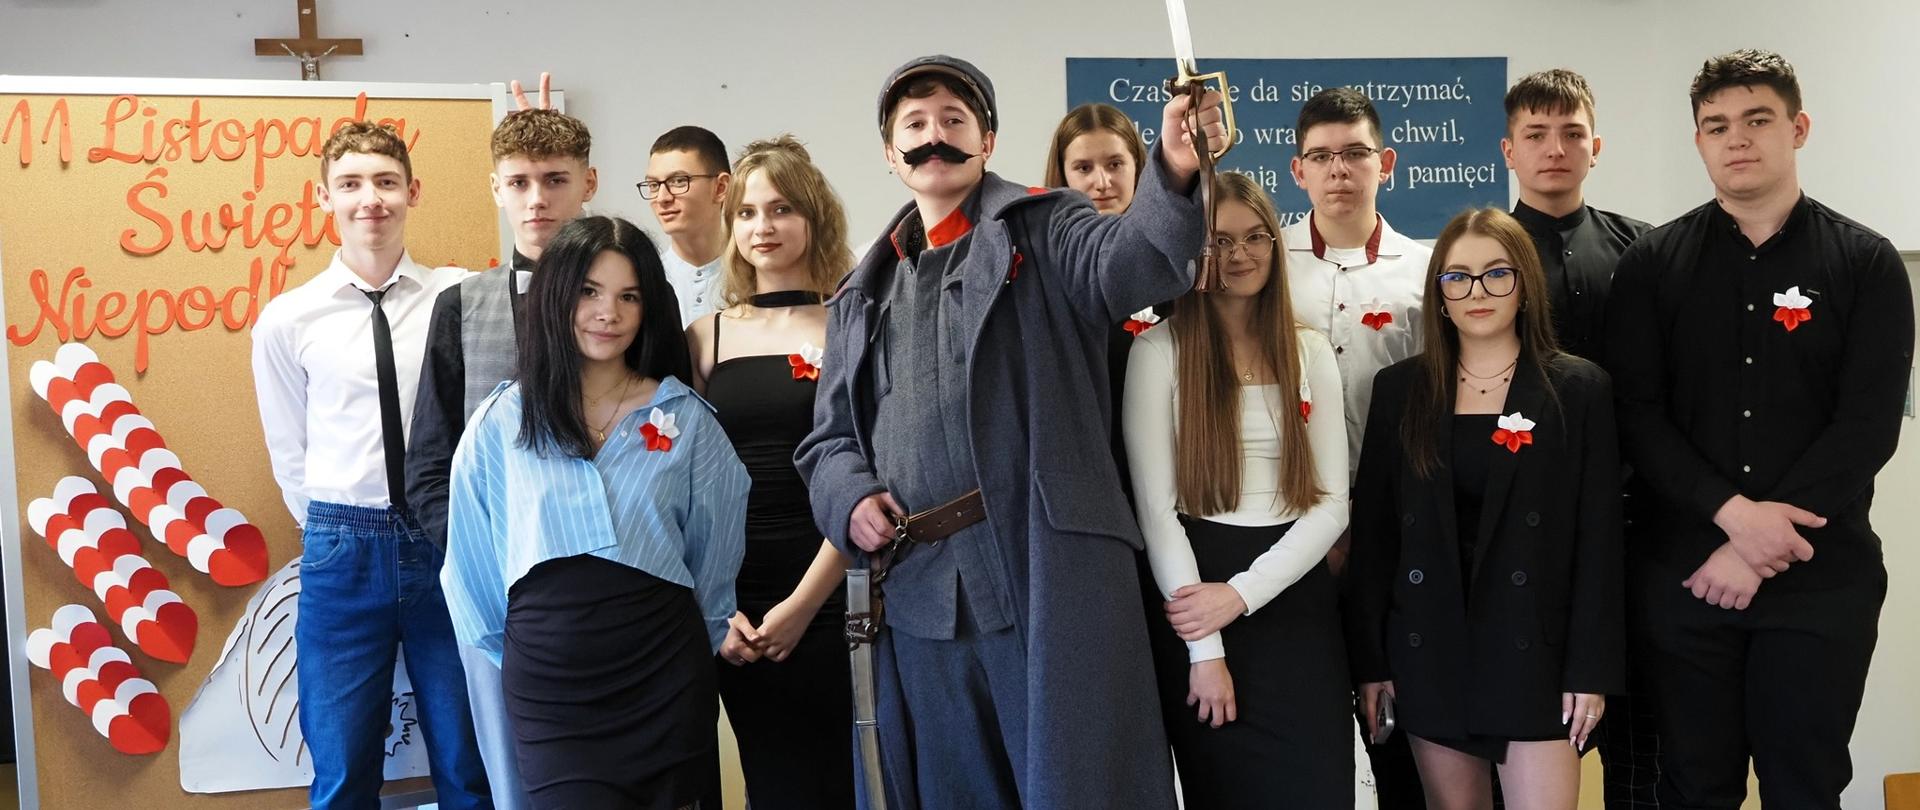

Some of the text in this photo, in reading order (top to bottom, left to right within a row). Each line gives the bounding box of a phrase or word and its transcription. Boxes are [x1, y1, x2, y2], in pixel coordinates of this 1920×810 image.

[1250, 78, 1279, 102] da
[1343, 76, 1472, 107] atrzymać,
[1, 98, 72, 165] 11
[1391, 118, 1465, 145] chwil,
[1408, 163, 1495, 190] pamięci
